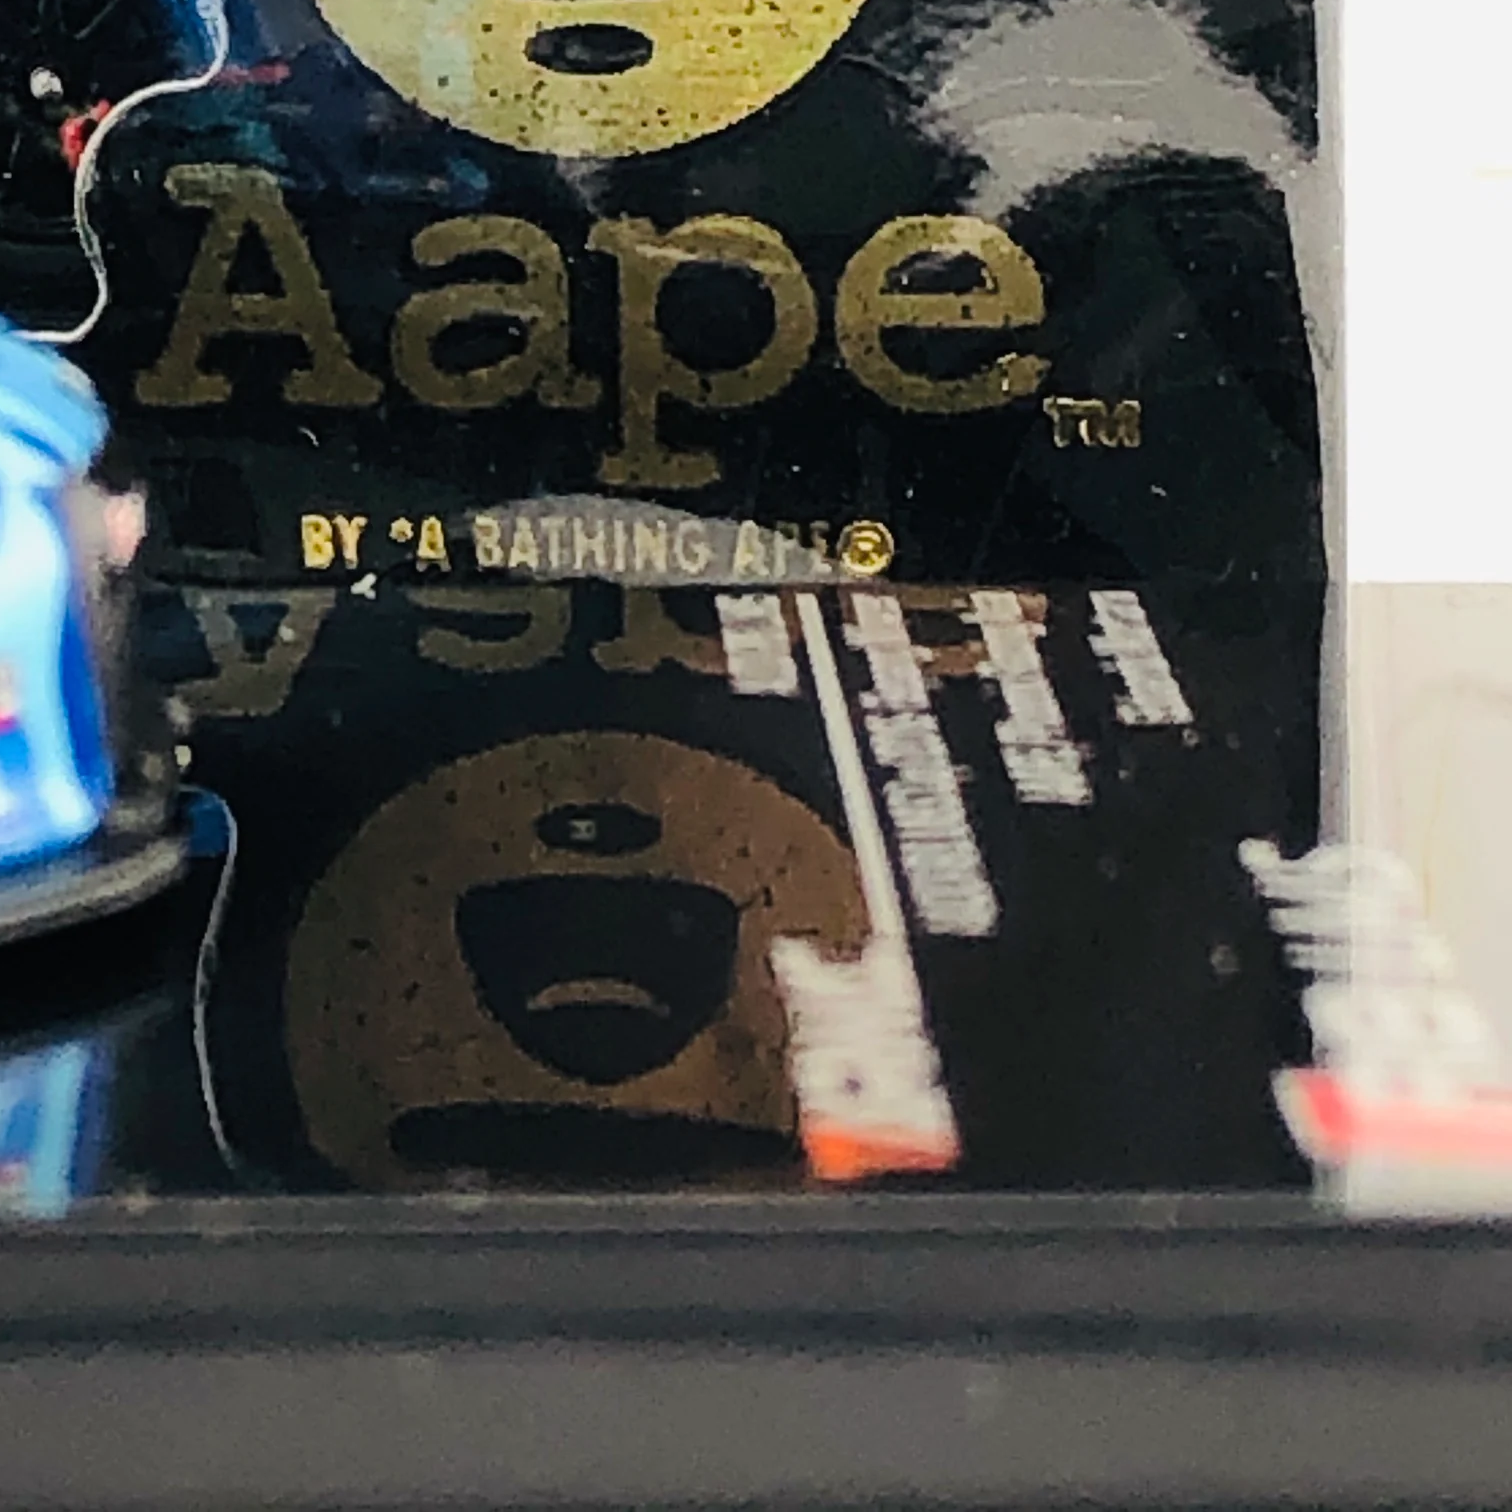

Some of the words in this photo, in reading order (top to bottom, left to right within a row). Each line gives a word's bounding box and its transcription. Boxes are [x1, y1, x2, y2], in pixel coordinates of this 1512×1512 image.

[136, 163, 1050, 486] Aape
[301, 514, 368, 570] BY
[473, 514, 711, 573] BATHING
